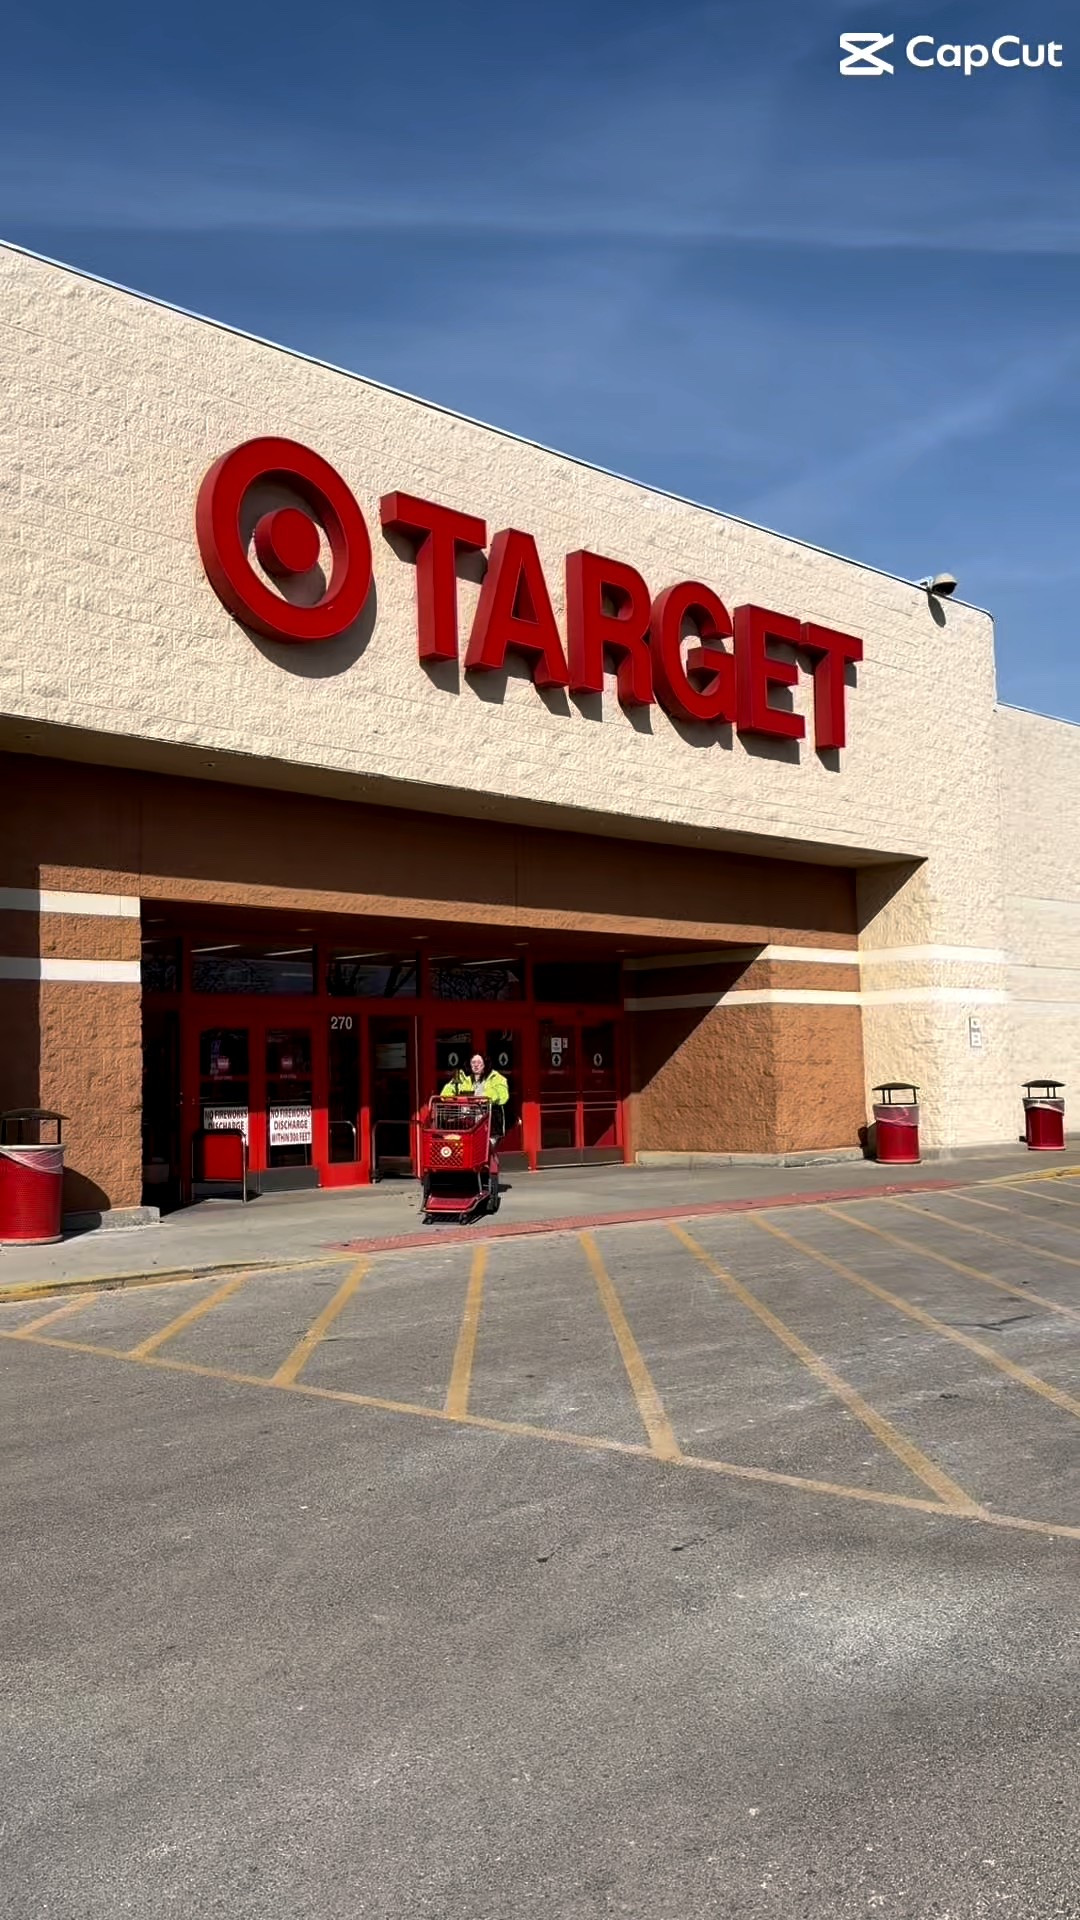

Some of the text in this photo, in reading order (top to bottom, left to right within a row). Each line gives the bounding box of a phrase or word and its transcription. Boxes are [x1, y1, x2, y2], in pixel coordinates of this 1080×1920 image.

[380, 490, 863, 750] TARGET
[330, 1015, 353, 1030] 270
[205, 1109, 248, 1120] NO FIREWORKS
[270, 1107, 311, 1119] NO FIREWORKS
[274, 1119, 308, 1130] DISCHARGE
